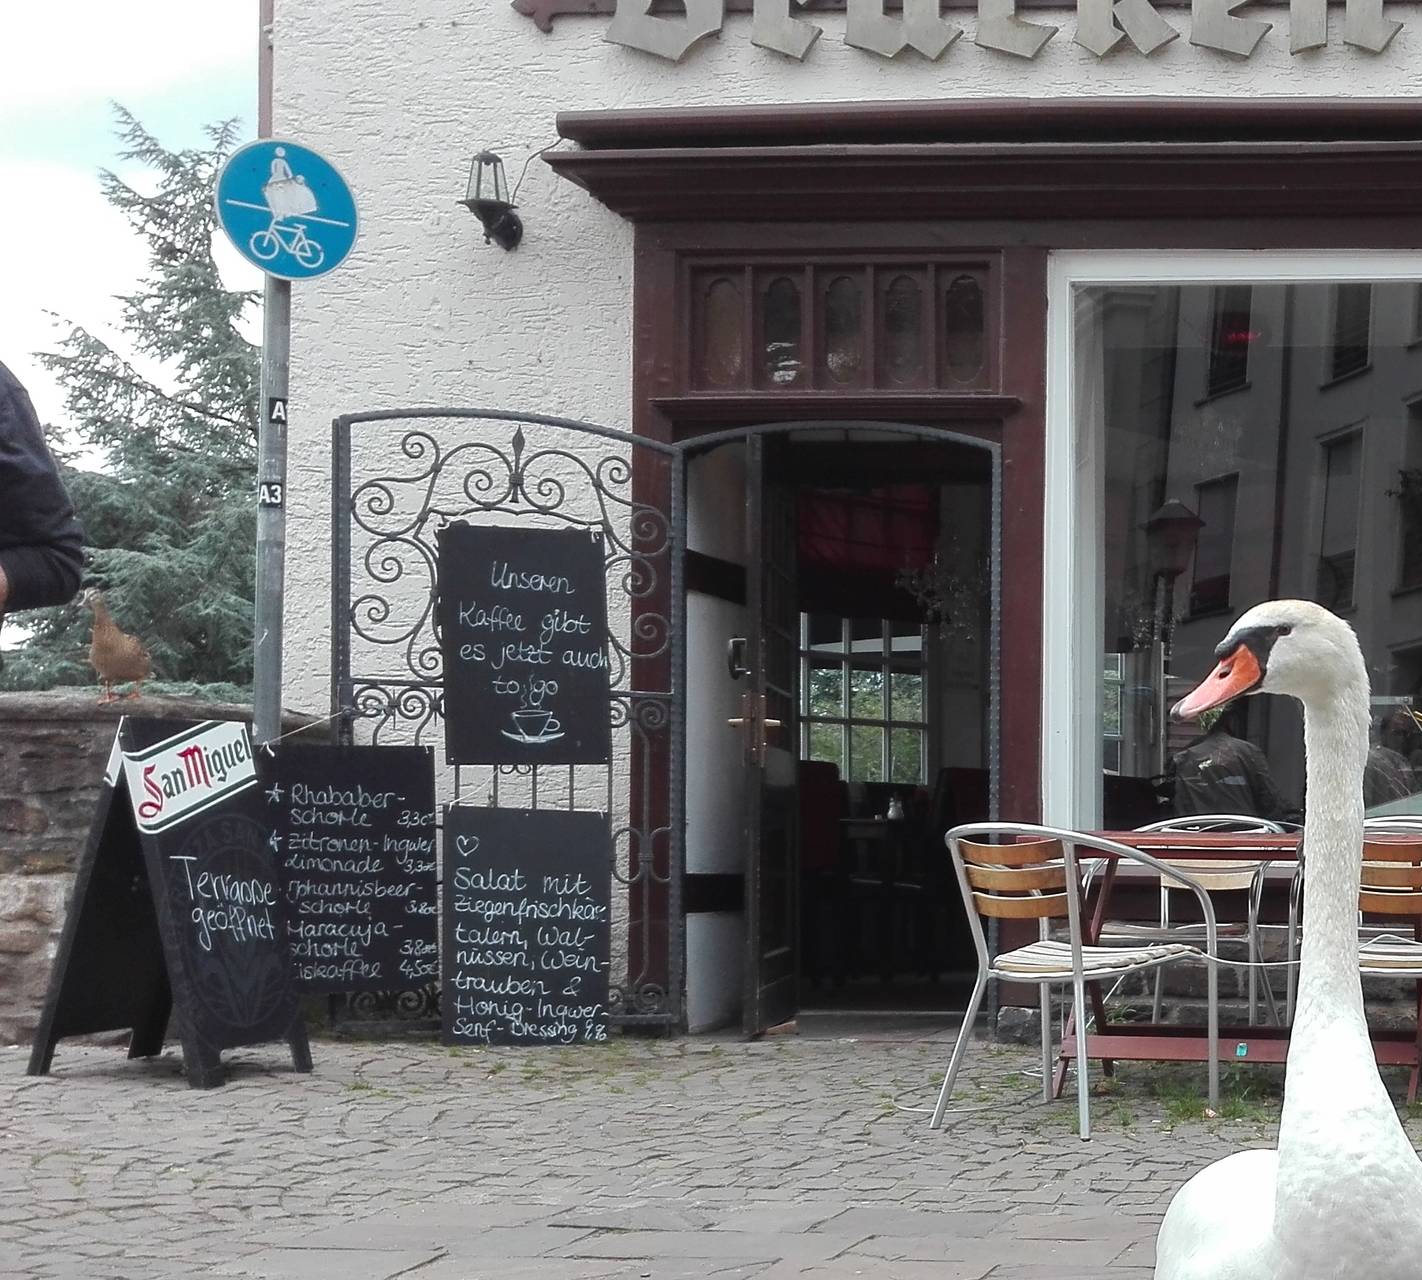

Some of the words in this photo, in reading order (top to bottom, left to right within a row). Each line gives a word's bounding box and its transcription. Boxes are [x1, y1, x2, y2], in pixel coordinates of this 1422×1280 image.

[259, 484, 282, 504] A3
[491, 560, 576, 595] Unseren
[459, 601, 527, 632] Kaffee
[539, 608, 592, 645] gibt
[460, 643, 486, 662] es
[490, 641, 553, 670] jetzt
[562, 646, 608, 669] auch
[492, 676, 520, 695] to
[529, 679, 559, 706] go
[454, 866, 527, 891] Salat
[543, 873, 592, 895] mit
[450, 971, 551, 996] trauben
[562, 976, 583, 997] &
